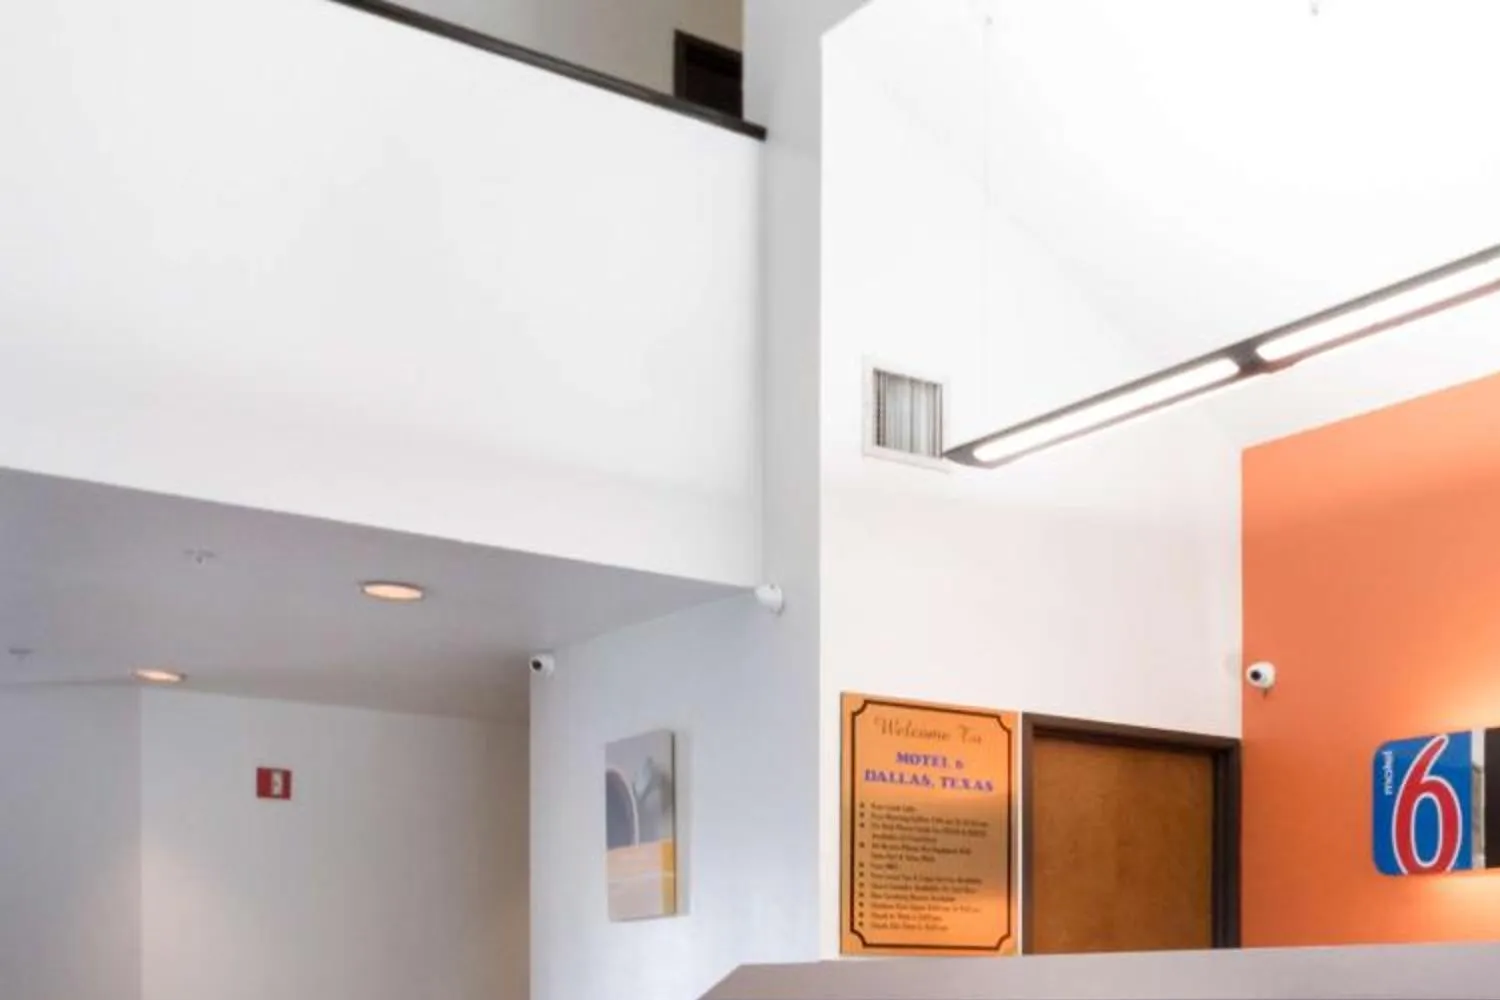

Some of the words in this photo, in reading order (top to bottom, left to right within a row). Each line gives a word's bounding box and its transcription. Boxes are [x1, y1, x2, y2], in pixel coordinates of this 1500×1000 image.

[896, 751, 949, 769] MOTEL
[864, 767, 935, 789] DALLAS,
[940, 776, 994, 793] TEXAS
[1382, 750, 1393, 796] motel
[1391, 735, 1462, 875] 6
